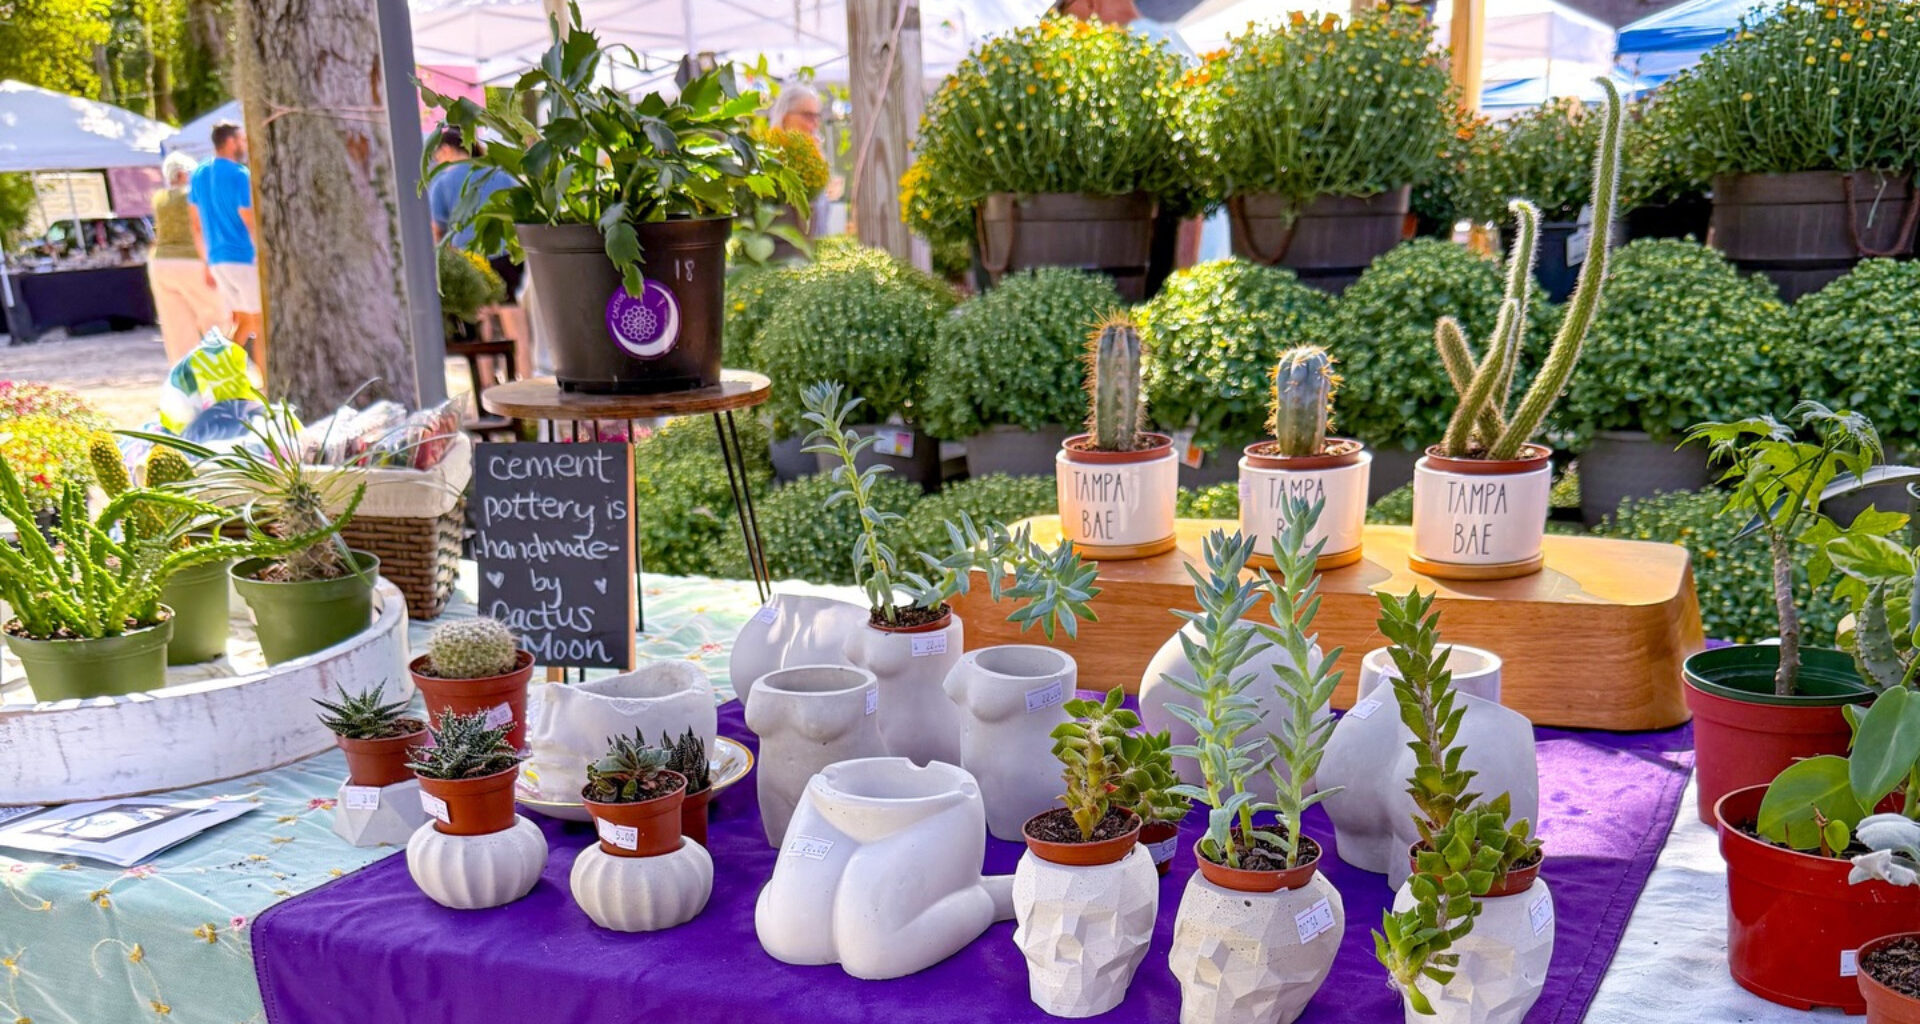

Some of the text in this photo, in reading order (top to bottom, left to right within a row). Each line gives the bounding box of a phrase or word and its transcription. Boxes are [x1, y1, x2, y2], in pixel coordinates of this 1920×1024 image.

[675, 259, 695, 282] 18
[489, 448, 615, 483] cement
[1073, 471, 1125, 502] TAMPA
[1447, 481, 1508, 514] TAMPA
[483, 491, 627, 539] pottery is
[1082, 509, 1114, 540] BAE
[1453, 523, 1493, 555] BAE
[529, 568, 562, 608] by
[491, 600, 596, 632] Cactus
[521, 632, 613, 663] Moon
[616, 830, 636, 842] 5.00
